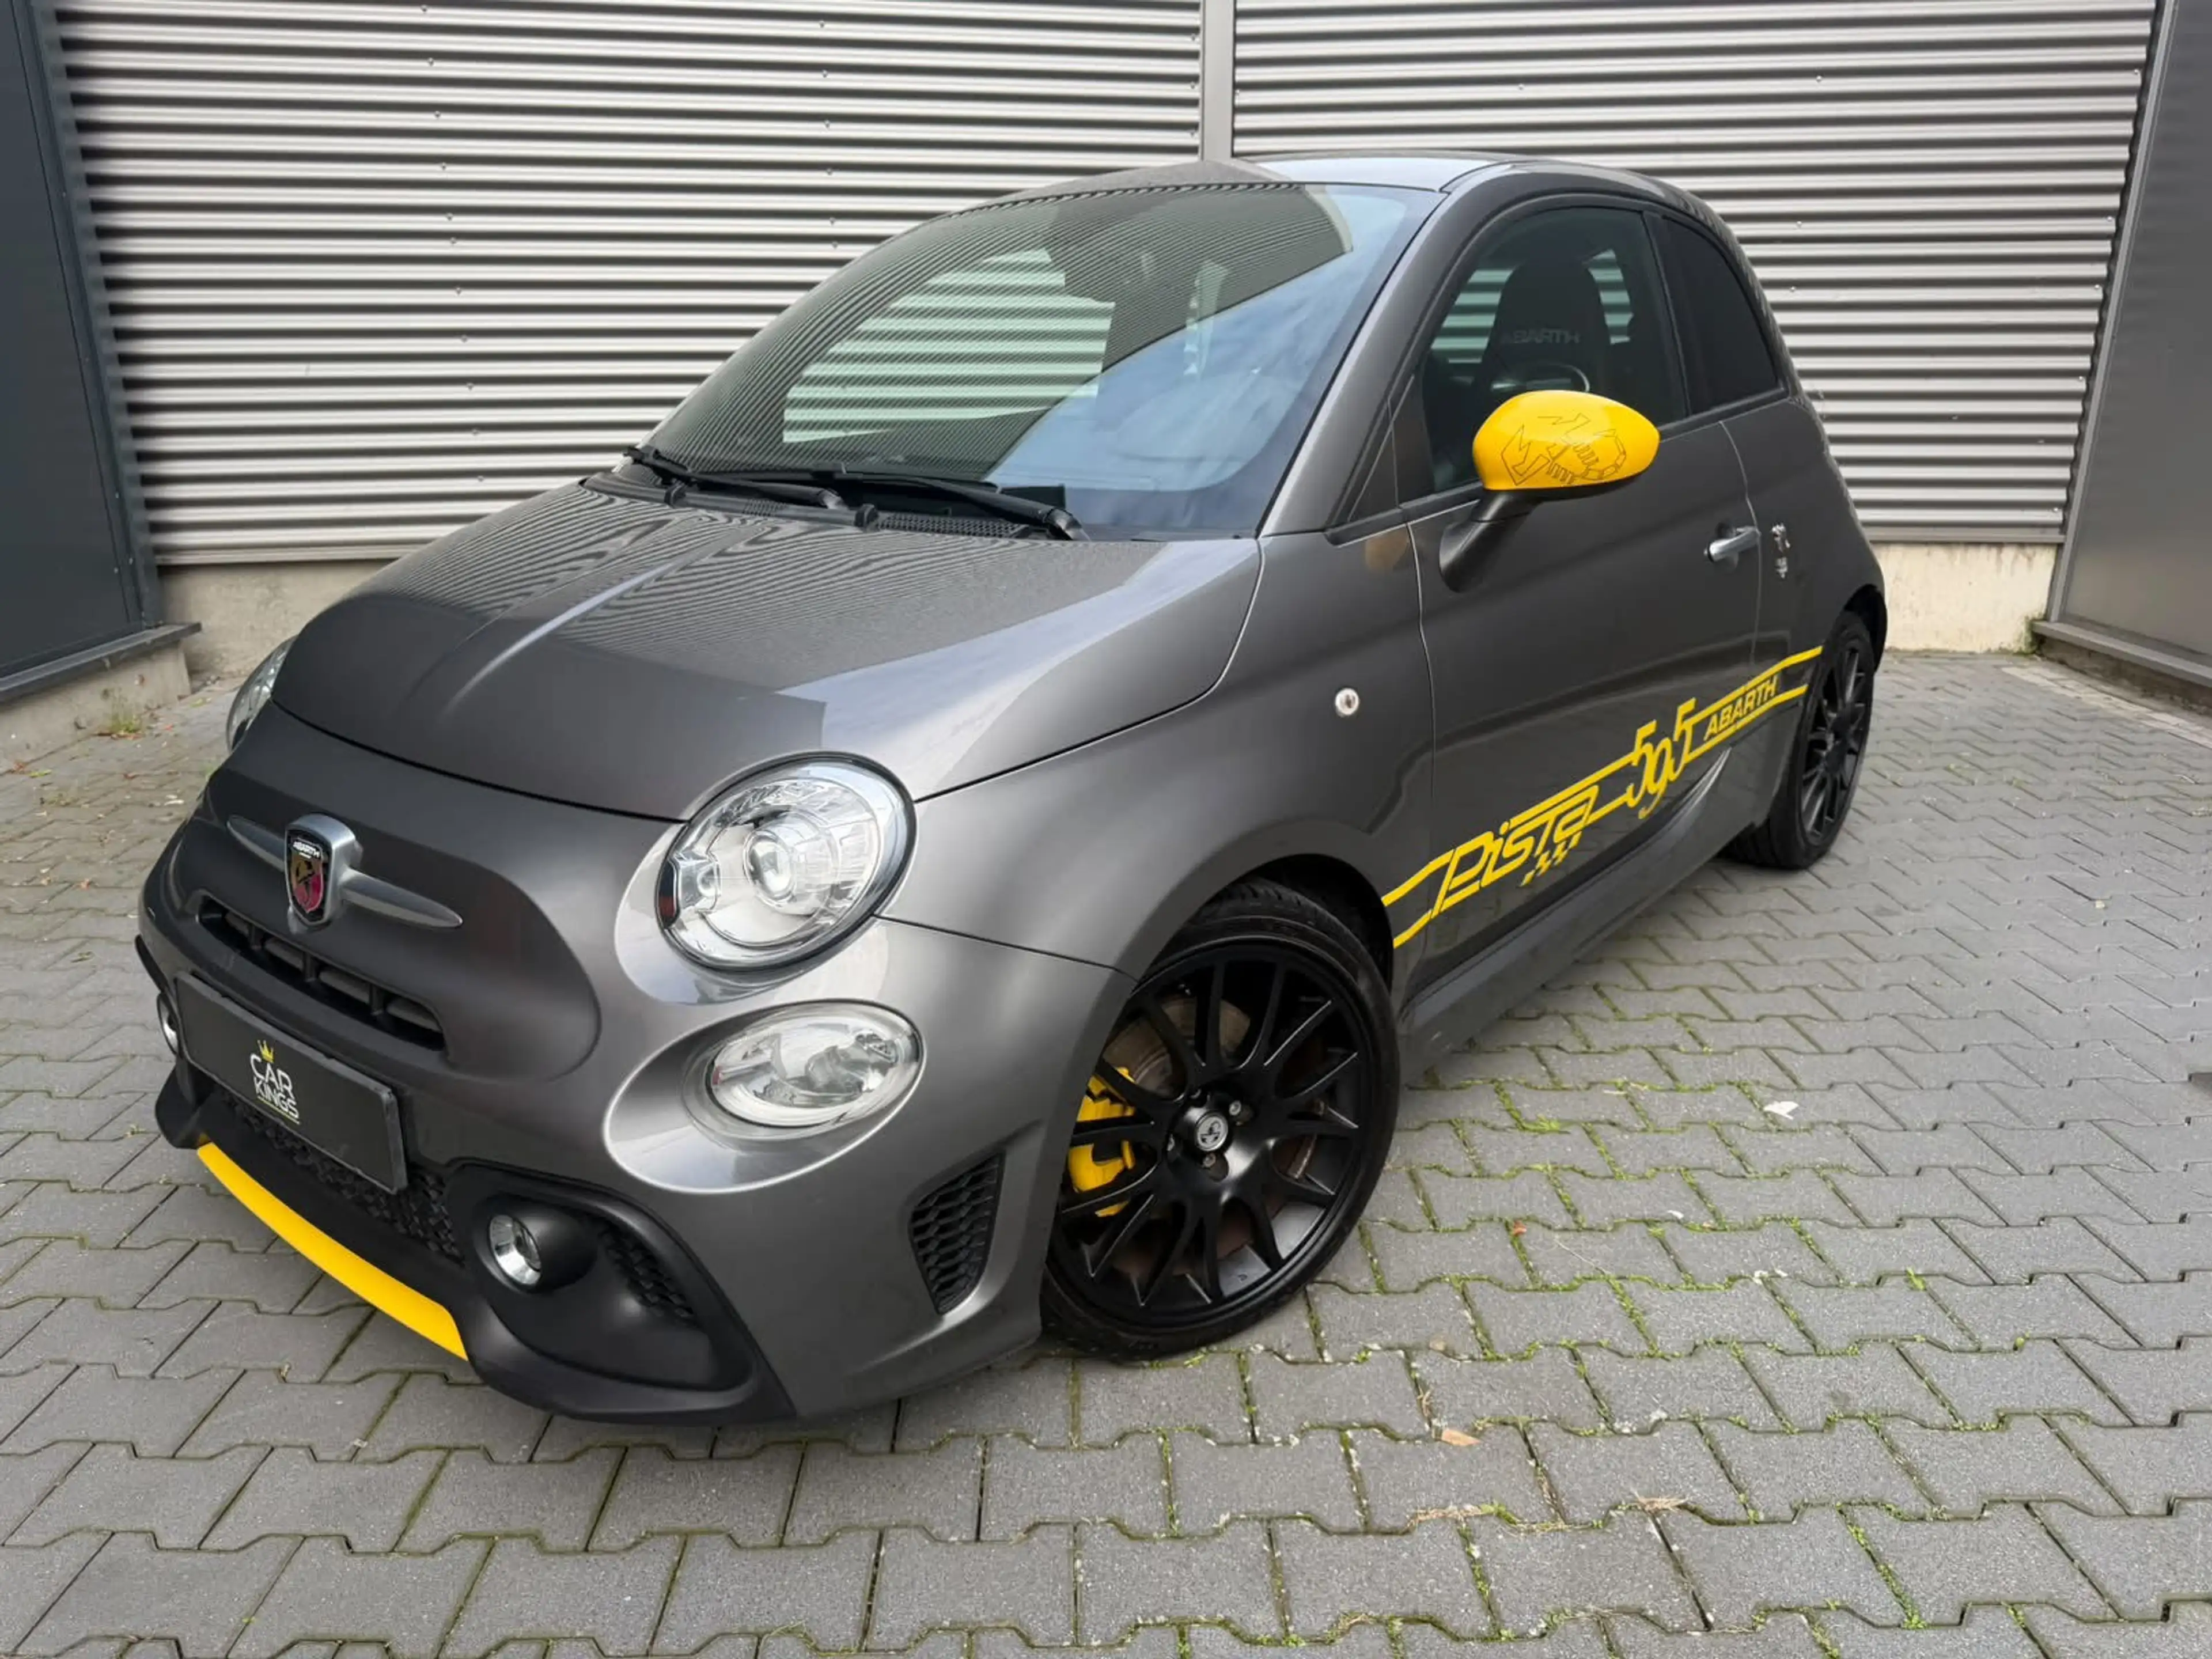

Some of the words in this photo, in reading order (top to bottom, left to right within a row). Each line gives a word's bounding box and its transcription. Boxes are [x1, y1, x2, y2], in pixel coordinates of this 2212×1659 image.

[1501, 328, 1581, 344] ABARTH
[1625, 697, 1696, 819] 595
[1703, 674, 1779, 741] ABARTH
[250, 1053, 295, 1101] CAR
[253, 1076, 299, 1119] KINGS
